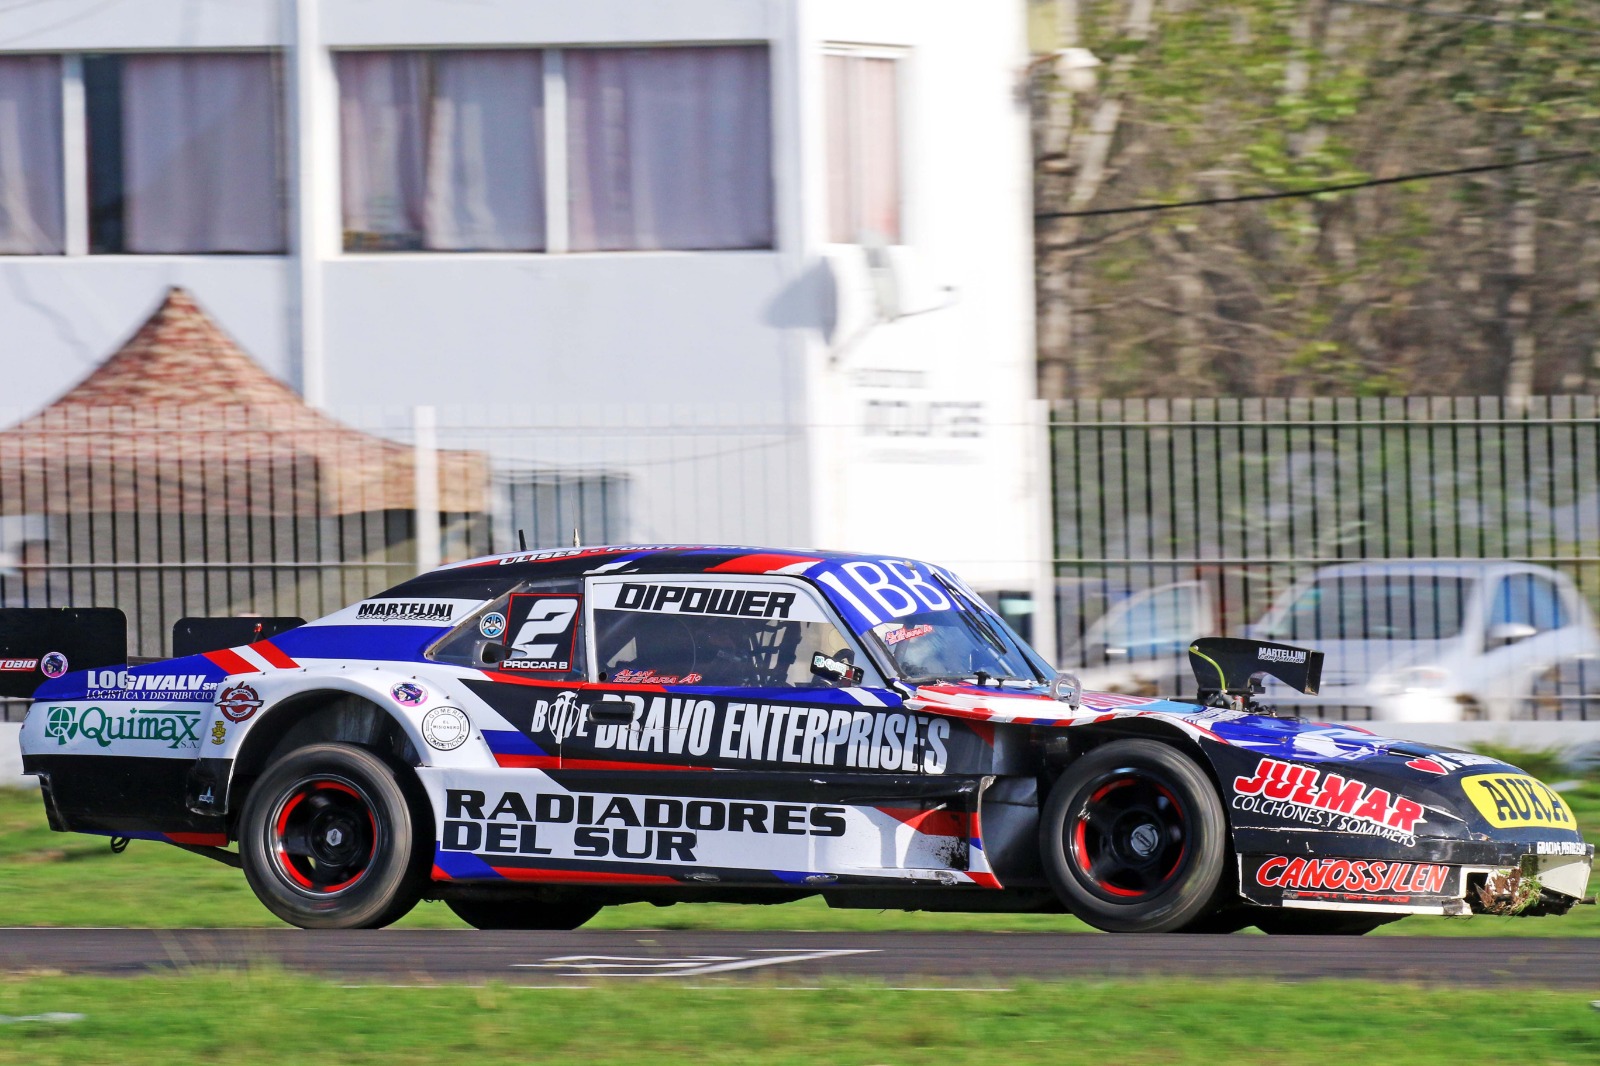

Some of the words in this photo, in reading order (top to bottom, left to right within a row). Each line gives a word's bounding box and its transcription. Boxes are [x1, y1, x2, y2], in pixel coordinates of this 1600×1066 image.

[357, 603, 454, 620] MARTELINI
[614, 583, 797, 618] DIPOWER
[510, 598, 578, 659] 2
[503, 660, 556, 669] PROCAR
[559, 661, 568, 669] B
[1259, 647, 1307, 660] MARTELLINI
[141, 691, 150, 700] Y
[150, 691, 217, 700] DISTRIBUCIO
[428, 708, 464, 720] GOMERIA
[78, 706, 201, 749] Quimax
[427, 734, 466, 749] COMPETICION
[719, 702, 951, 775] ENTERPRISES
[445, 788, 846, 837] RADIADORES
[1233, 758, 1427, 834] JULMAR
[1478, 778, 1569, 823] AUKA
[442, 820, 552, 854] DEL
[573, 827, 697, 861] SUR
[1232, 794, 1326, 826] COLCHONES
[1325, 812, 1338, 828] Y
[1337, 815, 1417, 848] SOMMIERS
